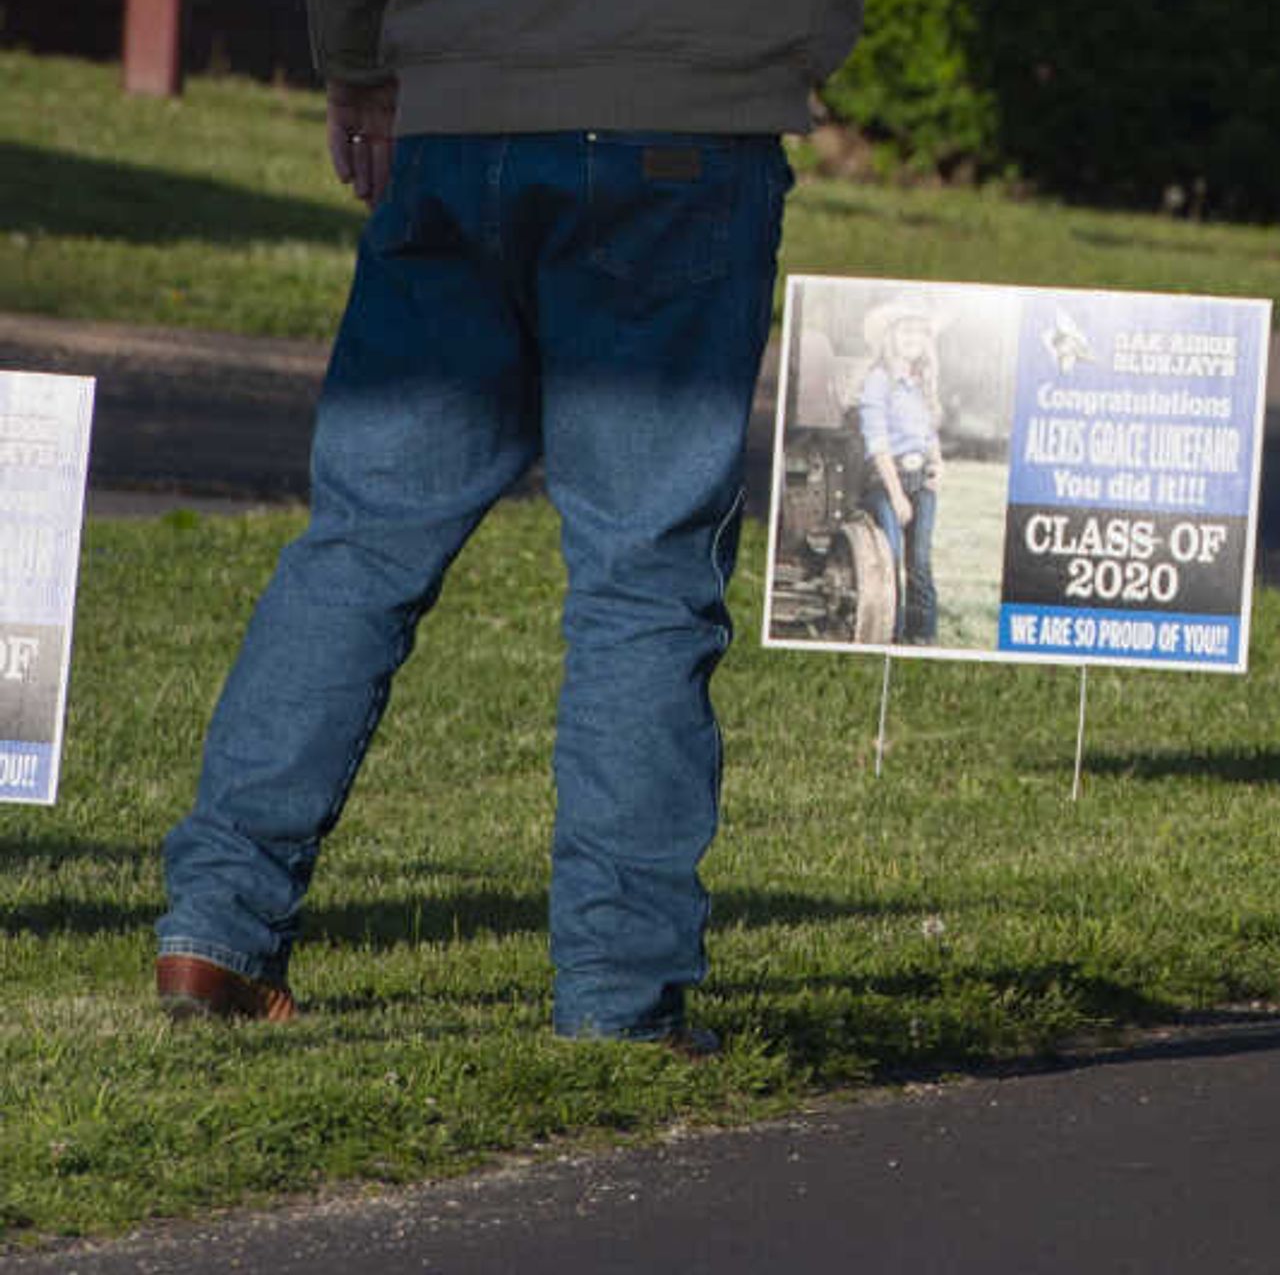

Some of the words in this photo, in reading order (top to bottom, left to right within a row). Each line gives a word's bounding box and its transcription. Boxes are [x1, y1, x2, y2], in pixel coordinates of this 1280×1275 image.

[1037, 383, 1233, 418] Congratulations
[1024, 416, 1086, 466] ALEXIS
[1090, 419, 1145, 470] GRACE
[1054, 470, 1099, 500] You
[1107, 472, 1151, 503] did
[1025, 515, 1156, 560] CLASS
[1170, 523, 1226, 563] OF
[1065, 558, 1179, 602] 2020
[1010, 614, 1037, 645] WE
[1039, 615, 1073, 646] ARE
[1075, 617, 1097, 649] SO
[1098, 619, 1156, 652] PROUD
[1159, 623, 1181, 653] OF
